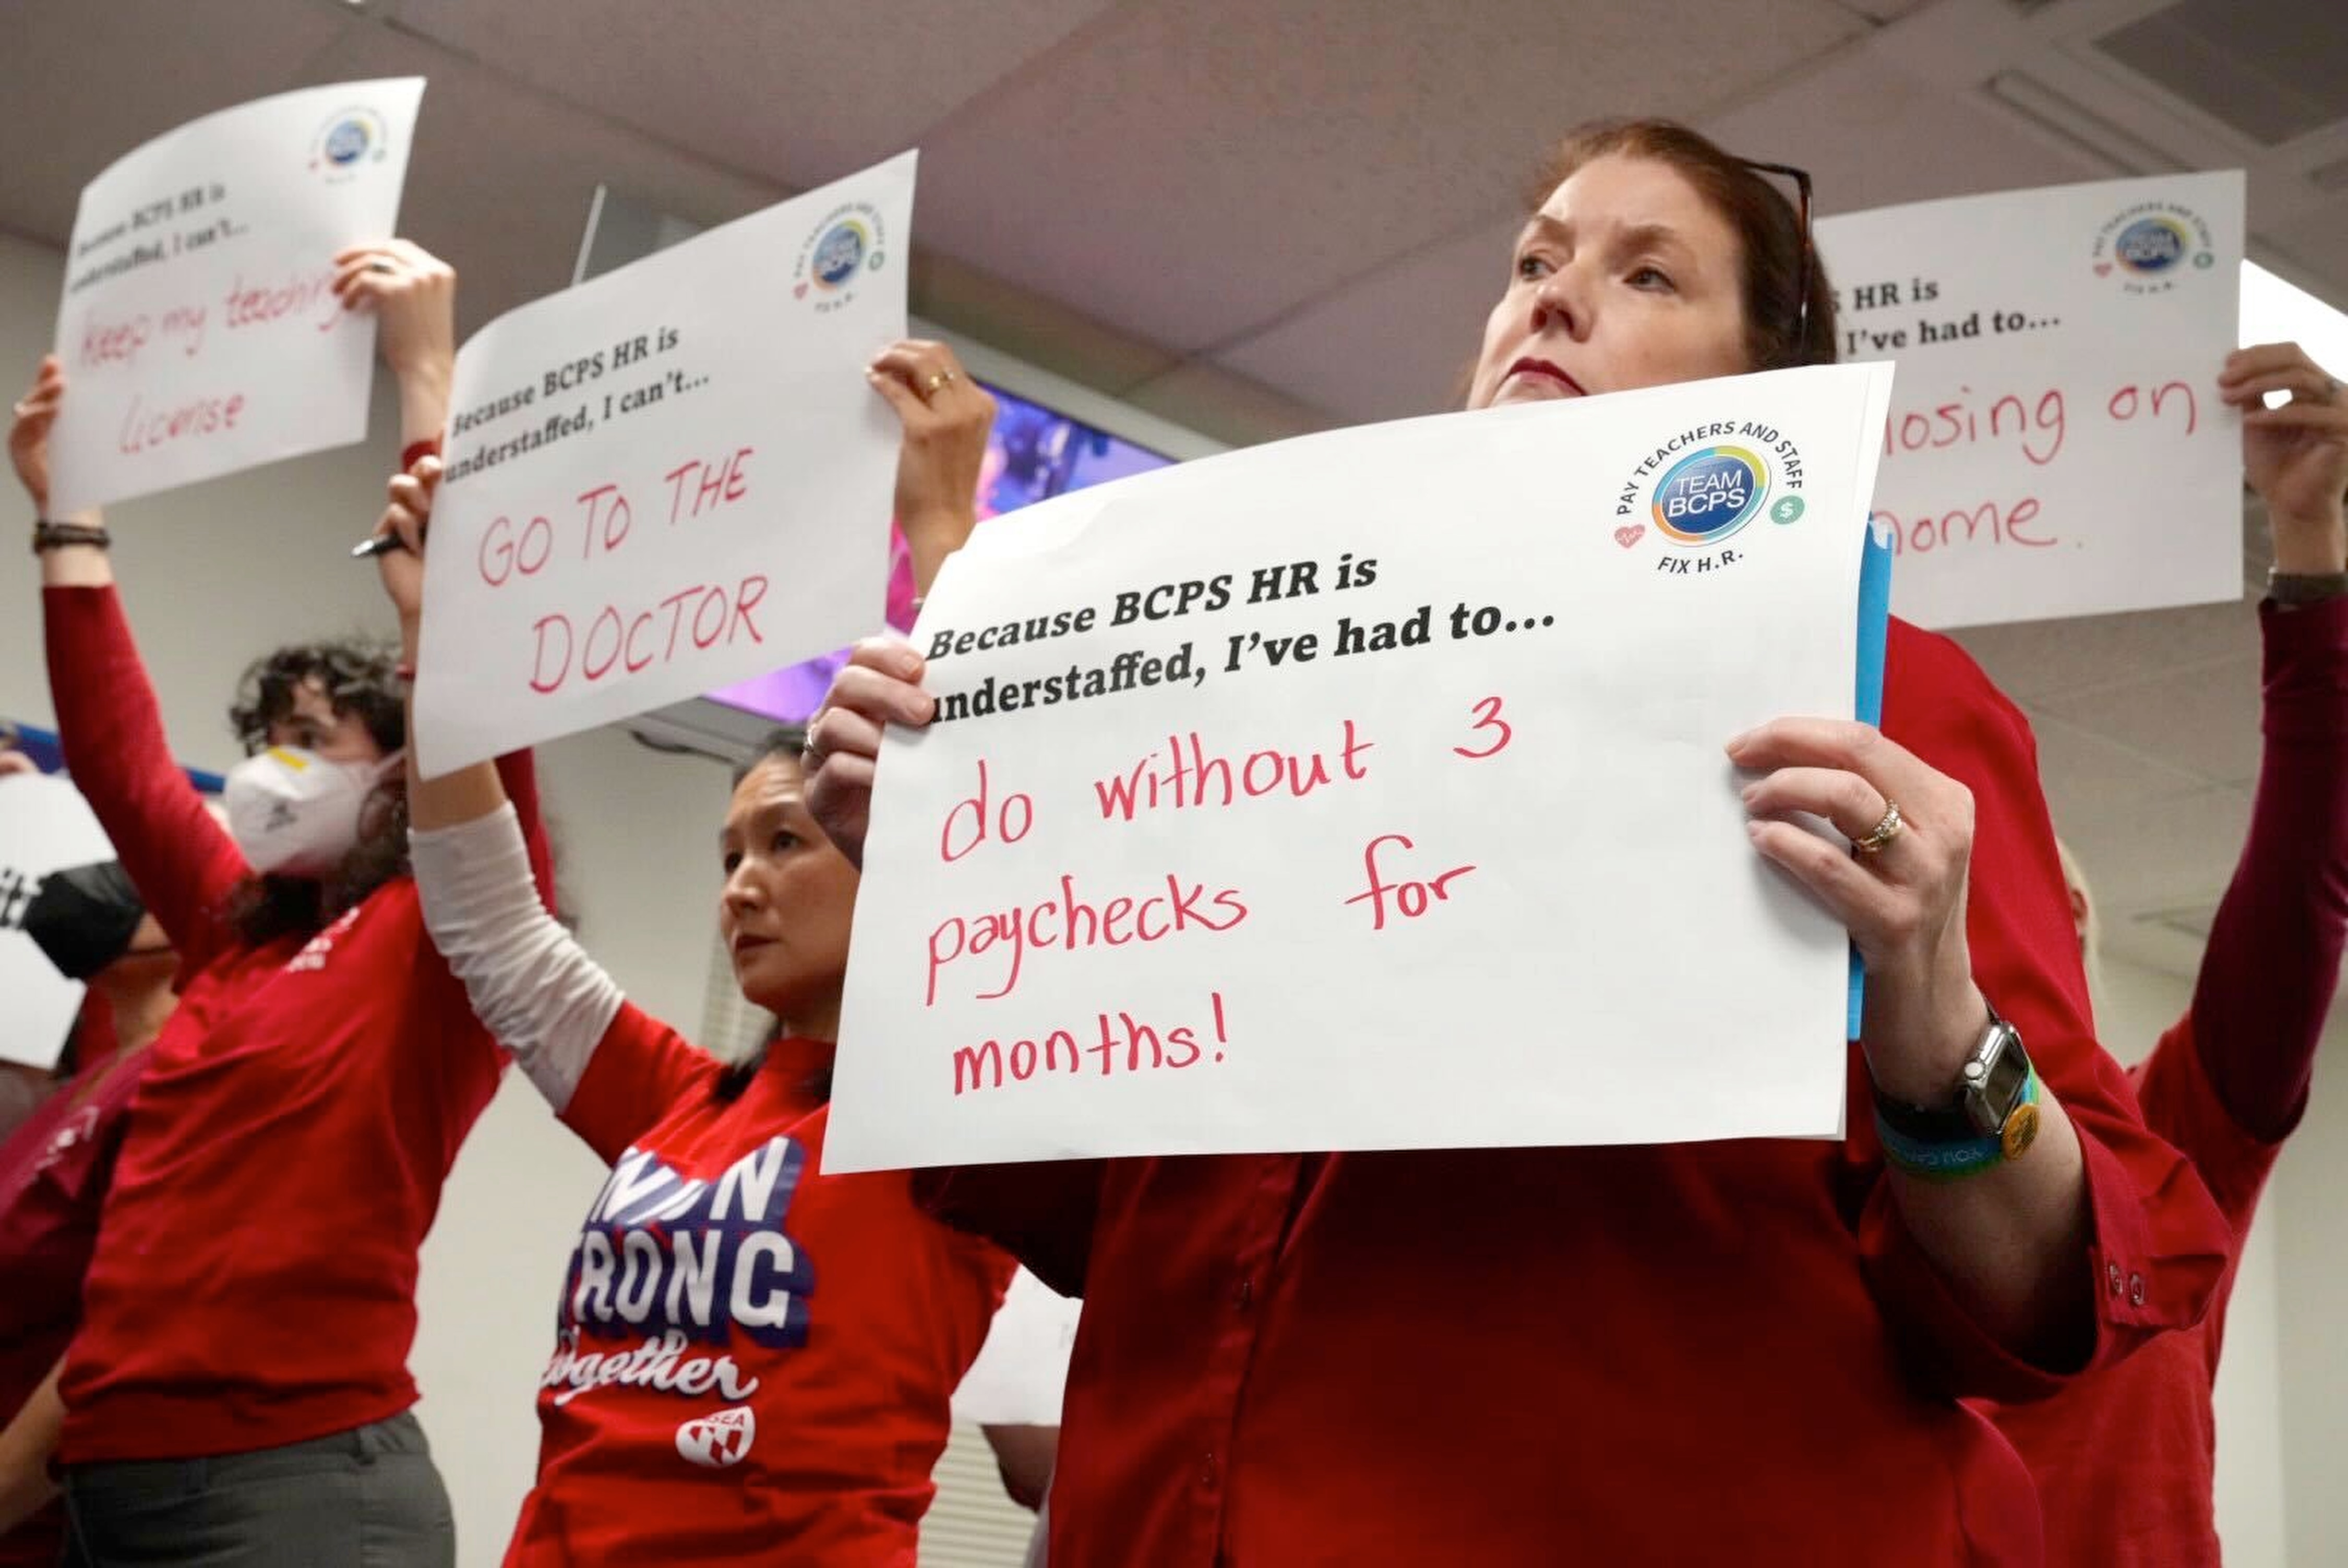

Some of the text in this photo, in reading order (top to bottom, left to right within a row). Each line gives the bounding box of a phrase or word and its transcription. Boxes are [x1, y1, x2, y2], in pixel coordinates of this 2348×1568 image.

[1854, 282, 1901, 311] HR
[1911, 278, 1939, 302] is
[543, 352, 604, 398] BCPS
[612, 335, 648, 369] HR
[657, 327, 678, 352] is
[1847, 310, 2061, 355] I've had to...
[603, 395, 612, 420] I
[2108, 380, 2197, 436] on
[1616, 421, 1803, 515] PAY TEACHERS AND STAFF
[1668, 488, 1745, 517] BCPS
[1676, 469, 1742, 496] TEAM
[478, 448, 754, 588] GO TO THE
[1658, 550, 1743, 574] FIX H.R.
[529, 574, 769, 694] DOCTOR
[926, 553, 1376, 661] Because BCPS HR is
[1225, 631, 1317, 673] I've
[1334, 606, 1431, 657] had
[1449, 602, 1554, 640] to...
[941, 695, 1513, 862] do without 3
[926, 834, 1477, 1006] paychecks for
[953, 992, 1227, 1095] months!
